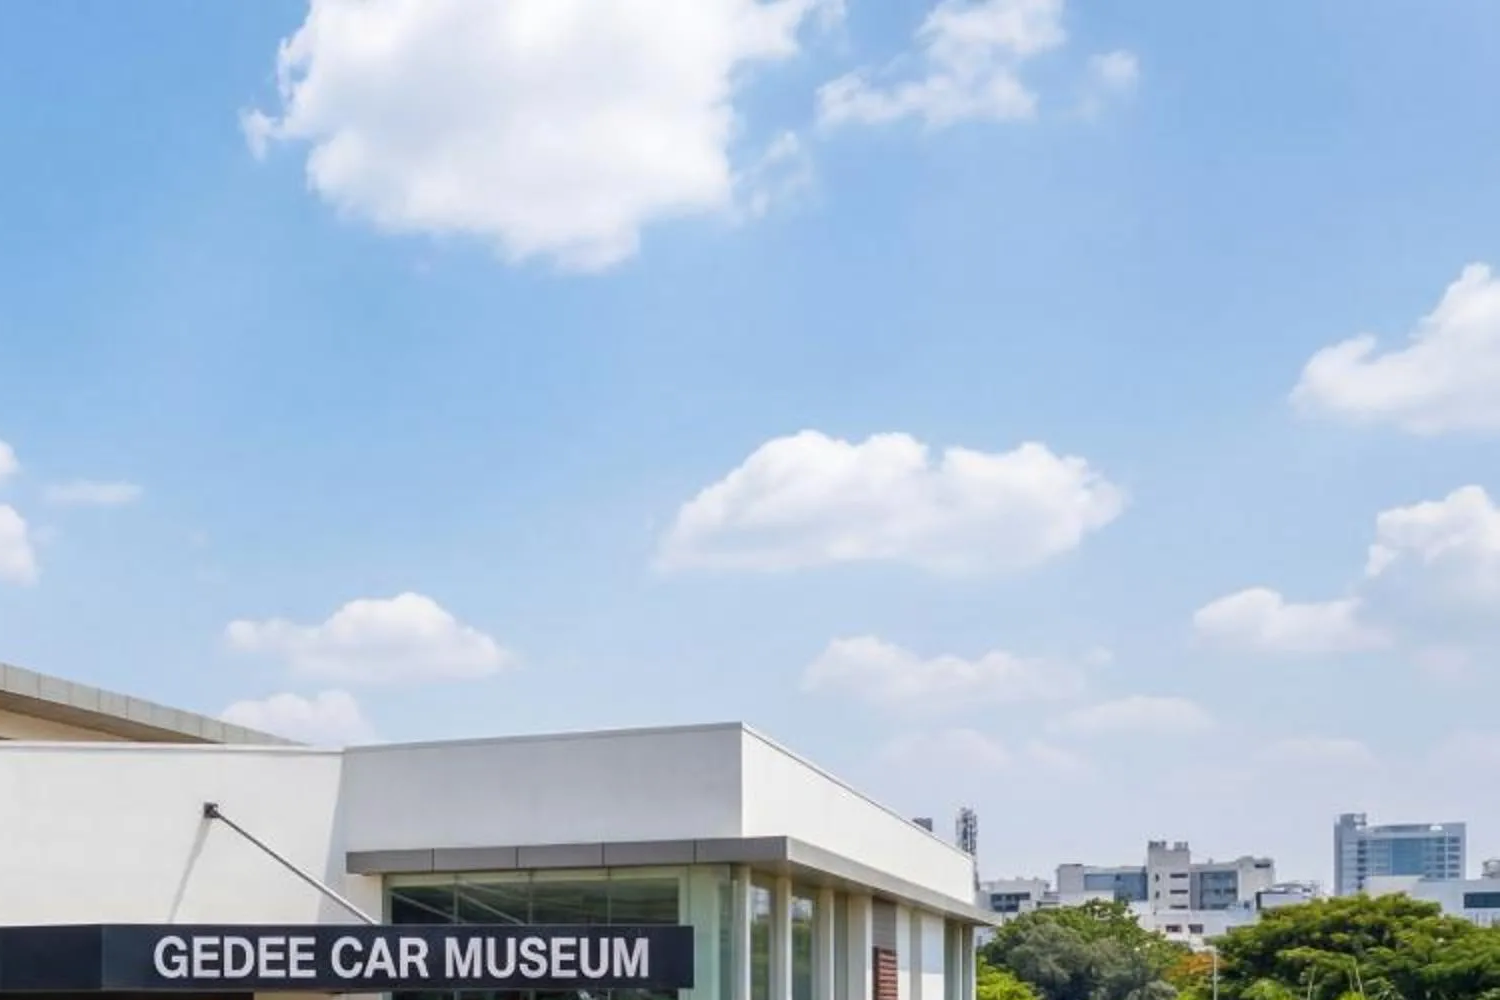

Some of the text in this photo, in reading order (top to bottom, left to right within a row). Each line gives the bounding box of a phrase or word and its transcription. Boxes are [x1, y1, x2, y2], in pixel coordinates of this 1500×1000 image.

[153, 935, 649, 979] GEDEE CAR MUSEUM
